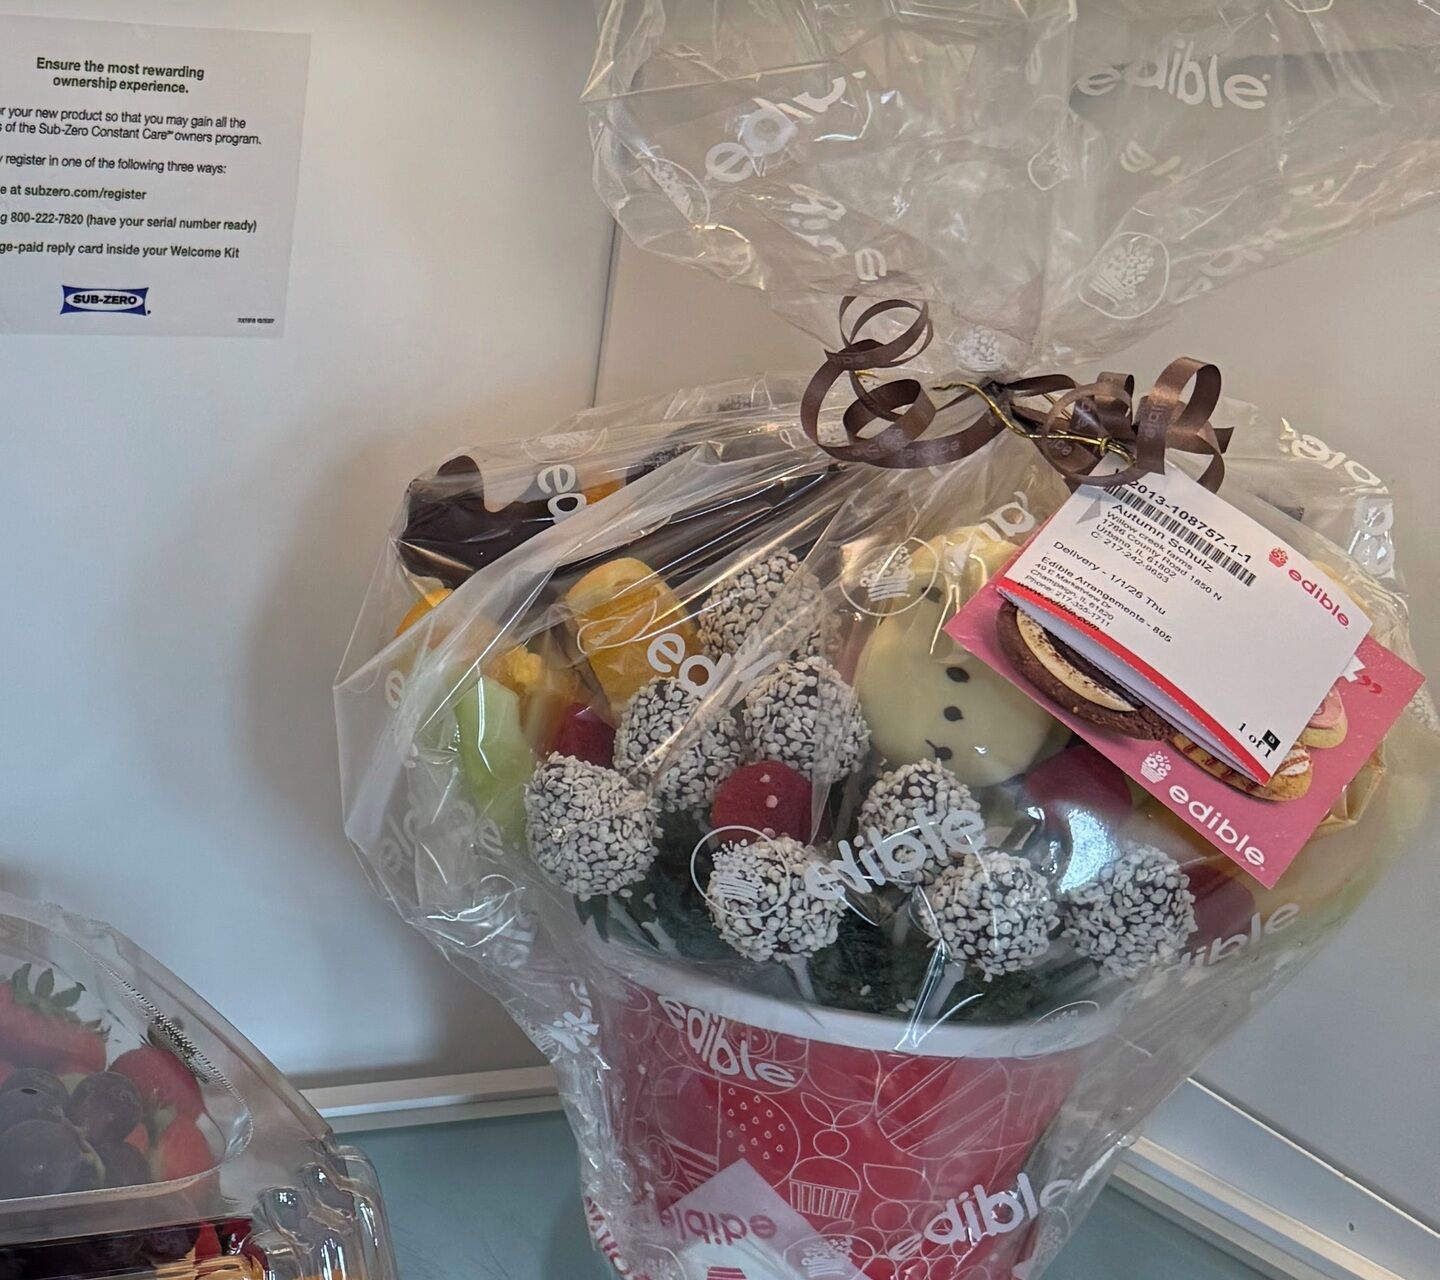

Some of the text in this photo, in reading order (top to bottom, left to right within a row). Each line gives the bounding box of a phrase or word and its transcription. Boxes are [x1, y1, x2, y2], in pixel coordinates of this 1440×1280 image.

[36, 57, 205, 81] Ensure the most rewarding
[53, 76, 189, 93] ownership experience.
[4, 121, 17, 133] of
[19, 122, 36, 134] the
[38, 123, 89, 136] Sub-Zero
[91, 125, 139, 139] Constant
[174, 131, 213, 143] owners
[215, 133, 262, 146] program.
[8, 107, 33, 119] your
[35, 108, 58, 119] new
[60, 109, 103, 121] product
[105, 112, 119, 122] so
[121, 111, 141, 124] that
[144, 114, 163, 126] you
[166, 116, 189, 128] may
[190, 116, 213, 129] gain
[215, 116, 227, 128] all
[229, 117, 247, 129] the
[5, 154, 47, 168] register
[48, 154, 60, 167] in
[61, 157, 82, 167] one
[84, 156, 97, 168] of
[98, 157, 115, 169] the
[117, 158, 165, 173] following
[167, 160, 194, 173] three
[196, 163, 227, 176] ways:
[10, 184, 22, 196] at
[24, 184, 147, 201] subzero.com/register
[10, 212, 84, 225] 800-222-7820
[86, 213, 117, 227] (have
[119, 217, 144, 229] your
[147, 216, 177, 228] serial
[179, 218, 221, 230] number
[223, 219, 257, 233] ready)
[46, 242, 75, 256] reply
[78, 243, 103, 254] card
[106, 243, 140, 256] inside
[142, 246, 168, 259] your
[170, 245, 221, 258] Welcome
[224, 247, 240, 259] Kit
[72, 294, 138, 306] SUB-ZERO
[1114, 468, 1252, 564] 2013-108757-1-1
[1096, 524, 1132, 550] Urbana,
[1107, 511, 1193, 570] Willow creek farms
[1112, 503, 1214, 573] Autumn Schulz
[1126, 532, 1161, 560] County
[1161, 553, 1187, 577] Road
[1025, 574, 1054, 593] Phone:
[1030, 569, 1078, 600] Champaign,
[1041, 556, 1074, 578] Edible
[1075, 576, 1146, 625] Arrangements
[1053, 540, 1101, 572] Delivery
[1146, 596, 1167, 616] Thu
[1055, 573, 1102, 604] Marketview
[1288, 569, 1351, 628] edible
[1248, 733, 1266, 750] of
[1169, 781, 1266, 869] edible
[804, 805, 986, 902] edible
[657, 995, 797, 1088] edible
[888, 1172, 1073, 1262] edible
